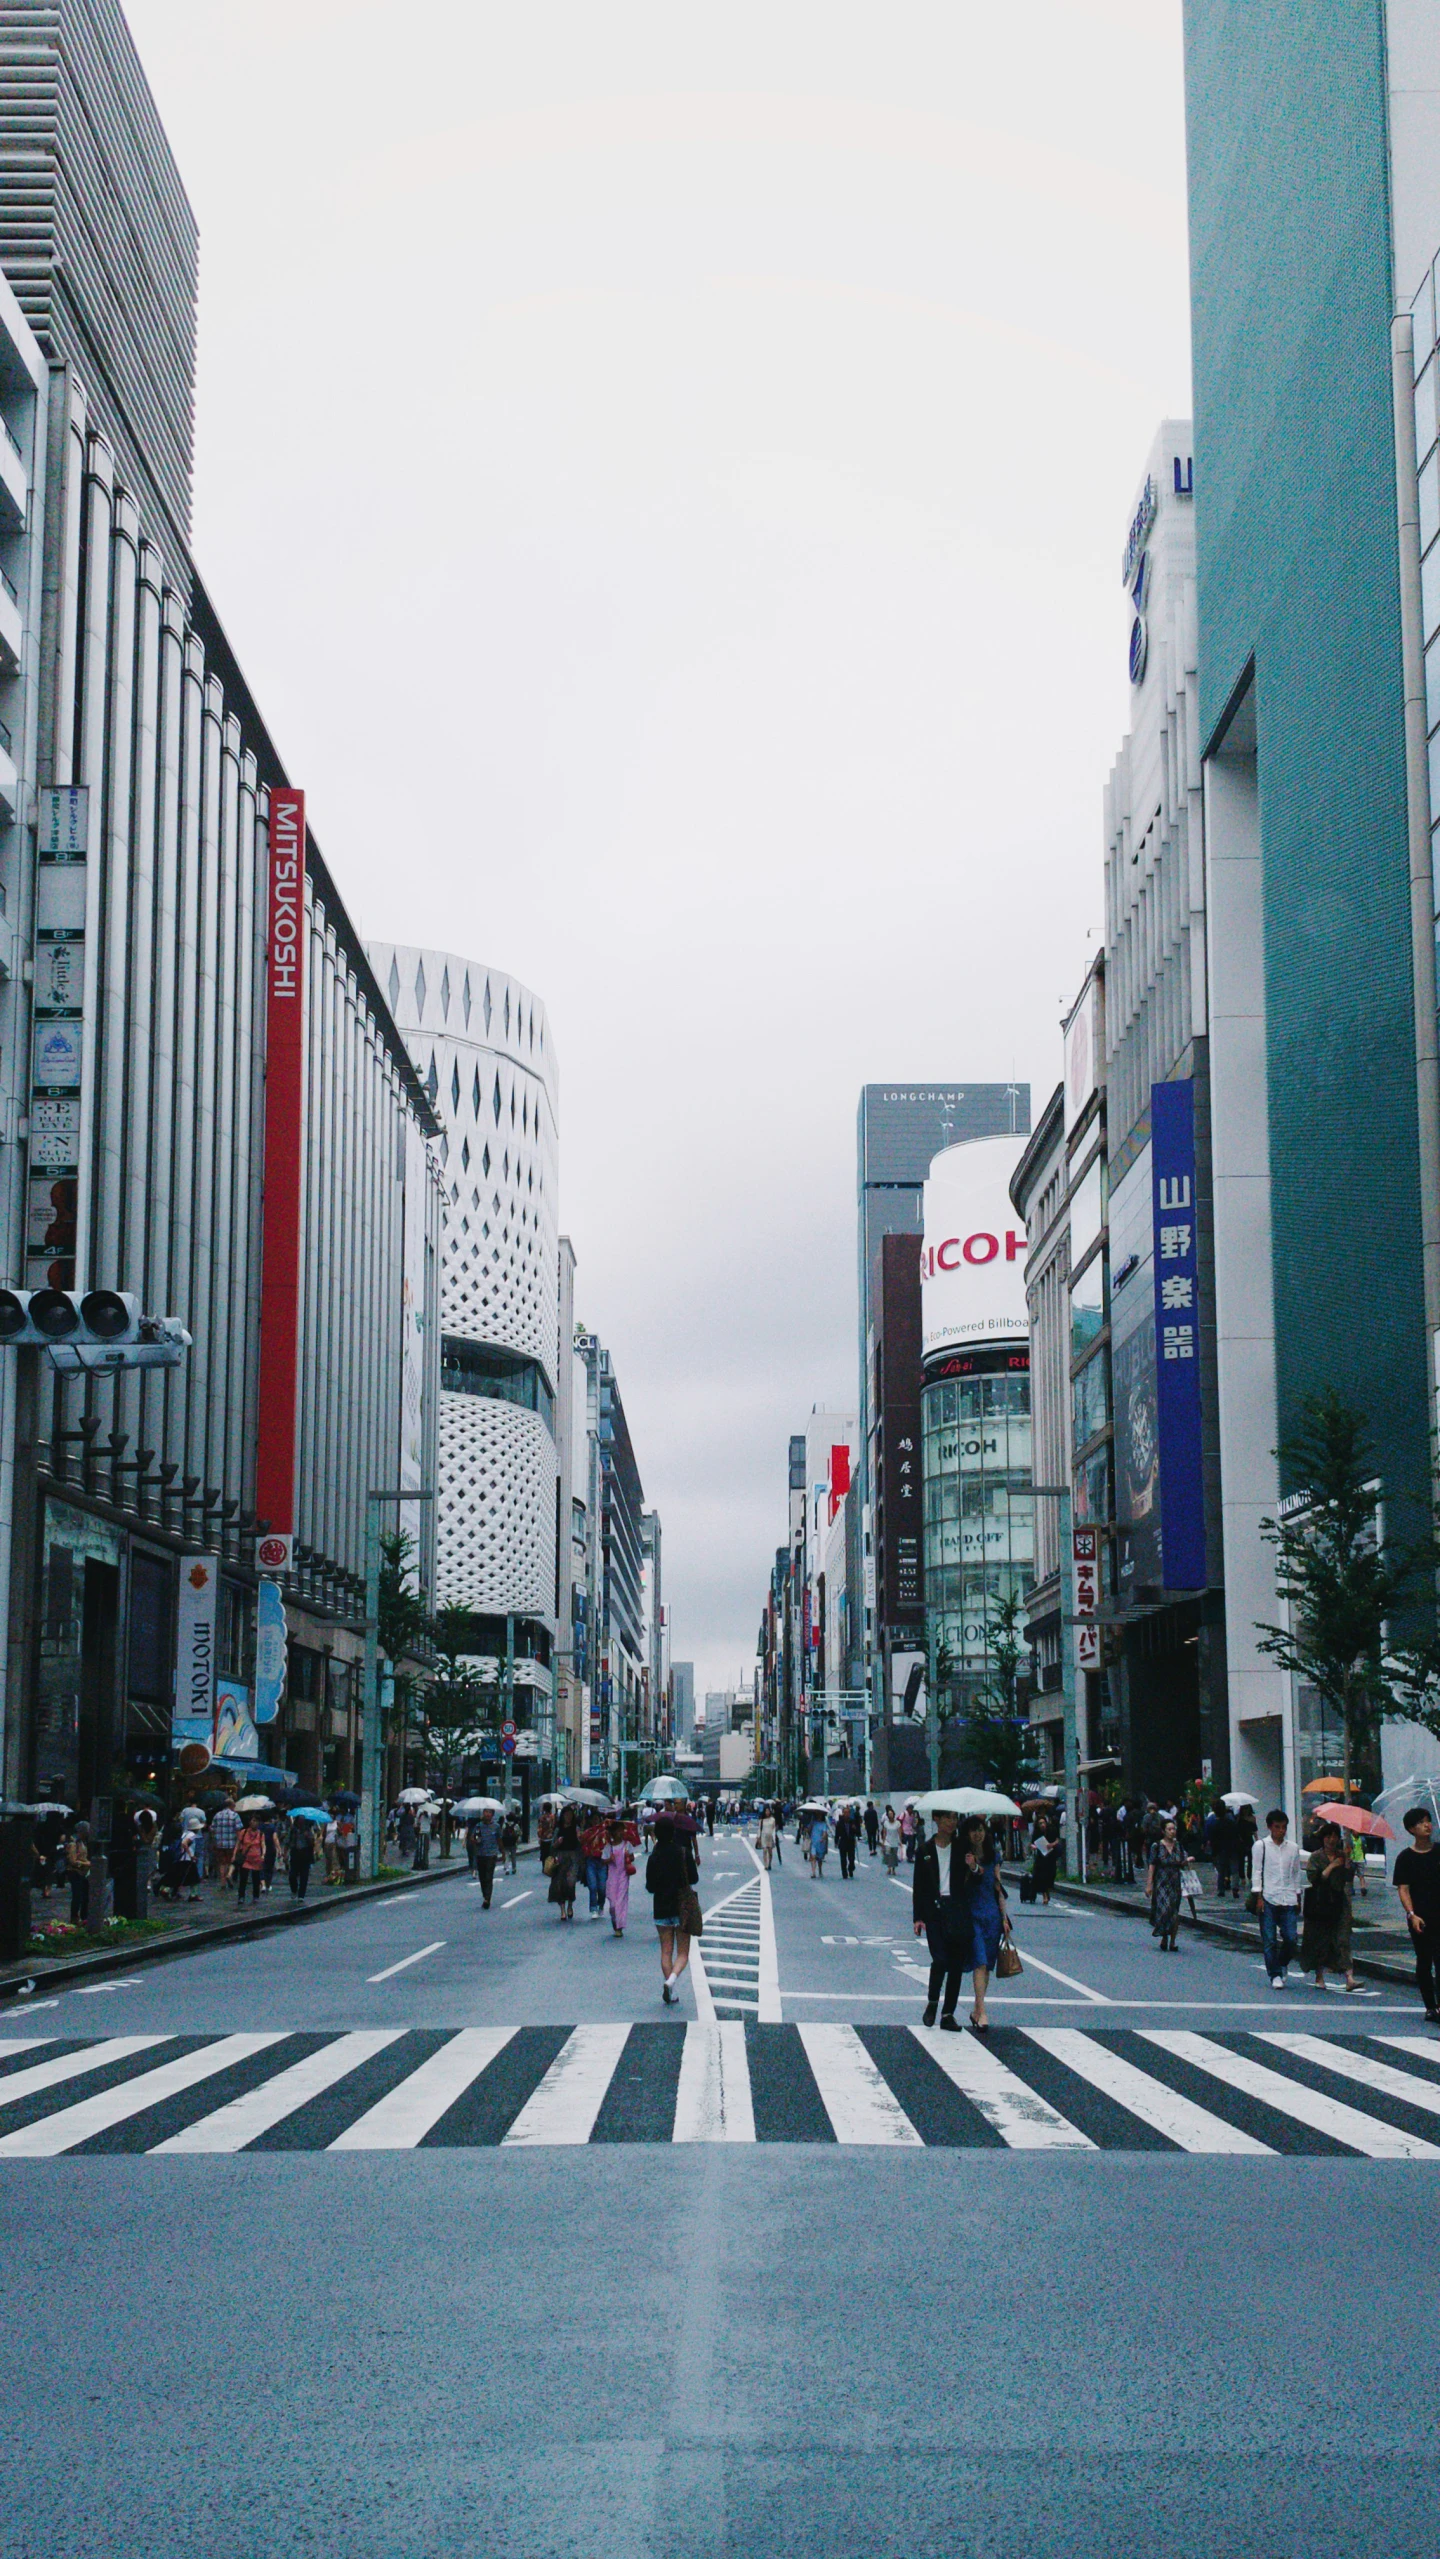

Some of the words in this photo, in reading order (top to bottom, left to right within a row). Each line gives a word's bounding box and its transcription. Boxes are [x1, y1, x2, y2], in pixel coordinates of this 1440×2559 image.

[274, 803, 298, 997] MITSUKOSHI
[54, 930, 73, 938] 8F
[883, 1092, 965, 1102] LONGCHAMP
[1159, 1175, 1194, 1361] 山野楽器
[930, 1320, 985, 1342] Eco-Powered
[938, 1439, 997, 1461] RICOH
[898, 1438, 914, 1498] 鳩居堂
[941, 1535, 973, 1547] RAND
[976, 1532, 1004, 1544] OFF
